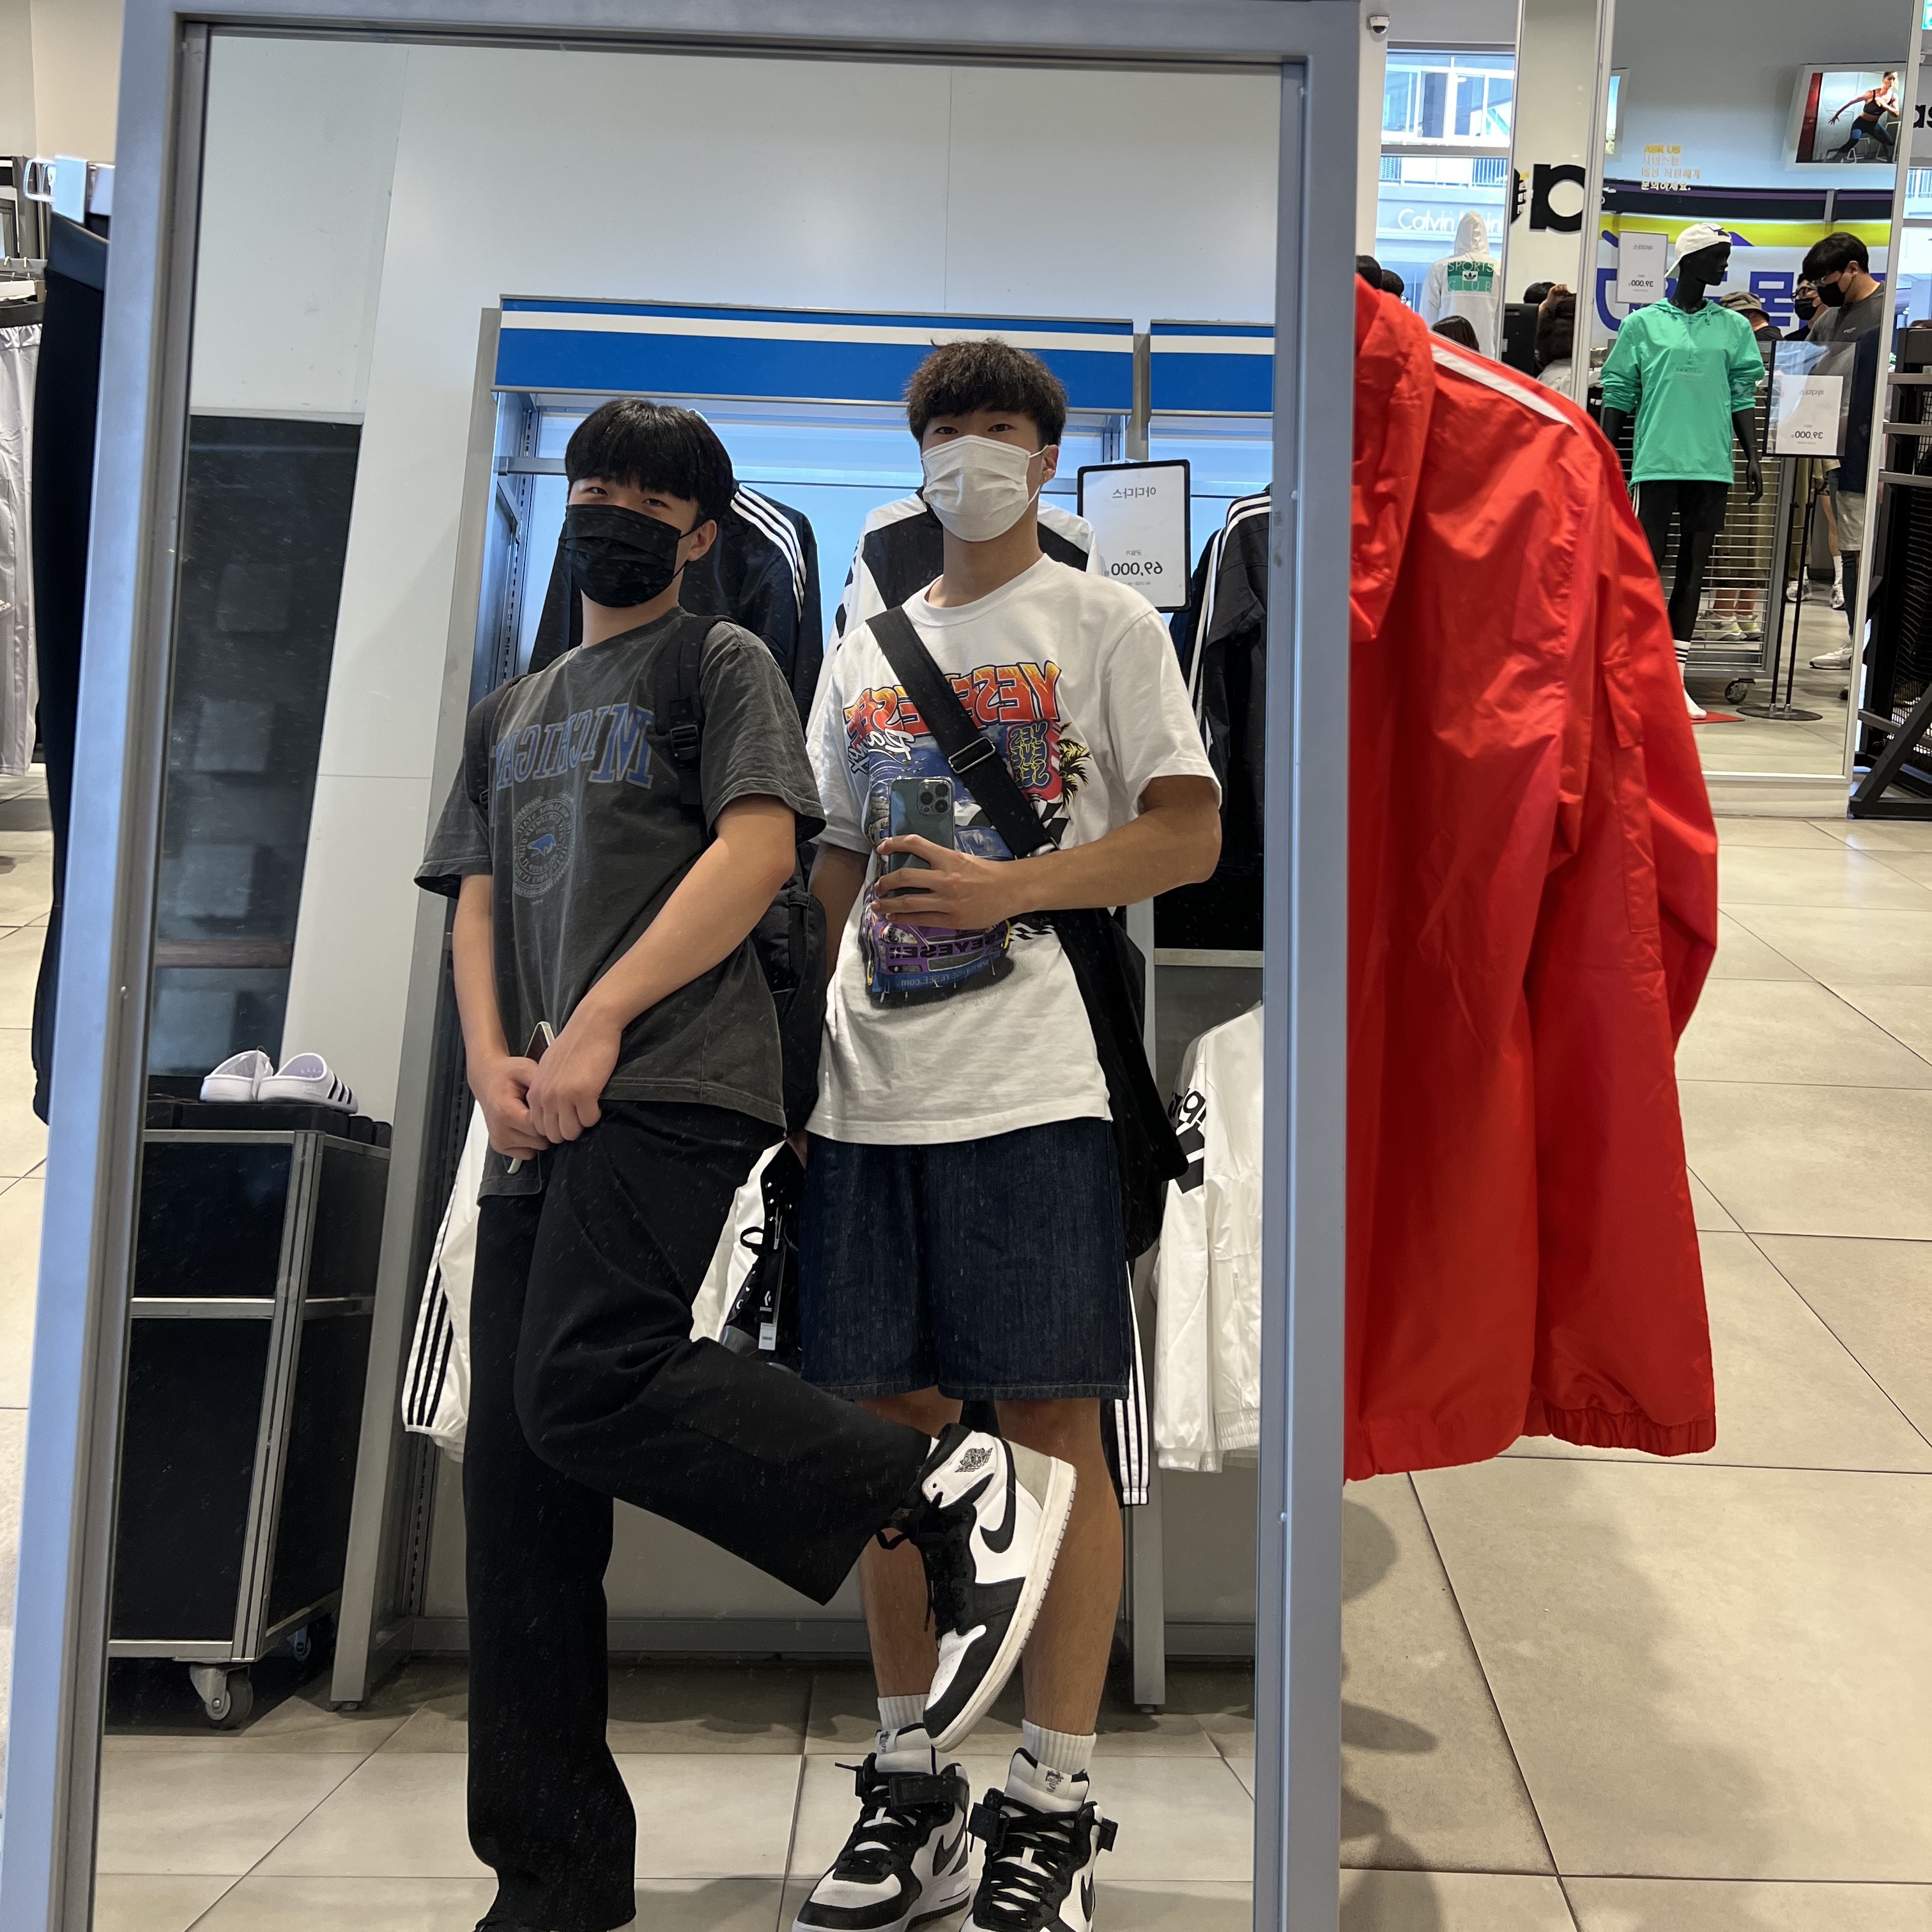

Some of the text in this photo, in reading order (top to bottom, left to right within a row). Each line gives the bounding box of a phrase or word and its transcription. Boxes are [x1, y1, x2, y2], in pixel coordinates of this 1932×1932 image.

[1397, 208, 1455, 232] Calvin
[1447, 261, 1494, 273] SPORTS
[1447, 280, 1492, 293] CLUB
